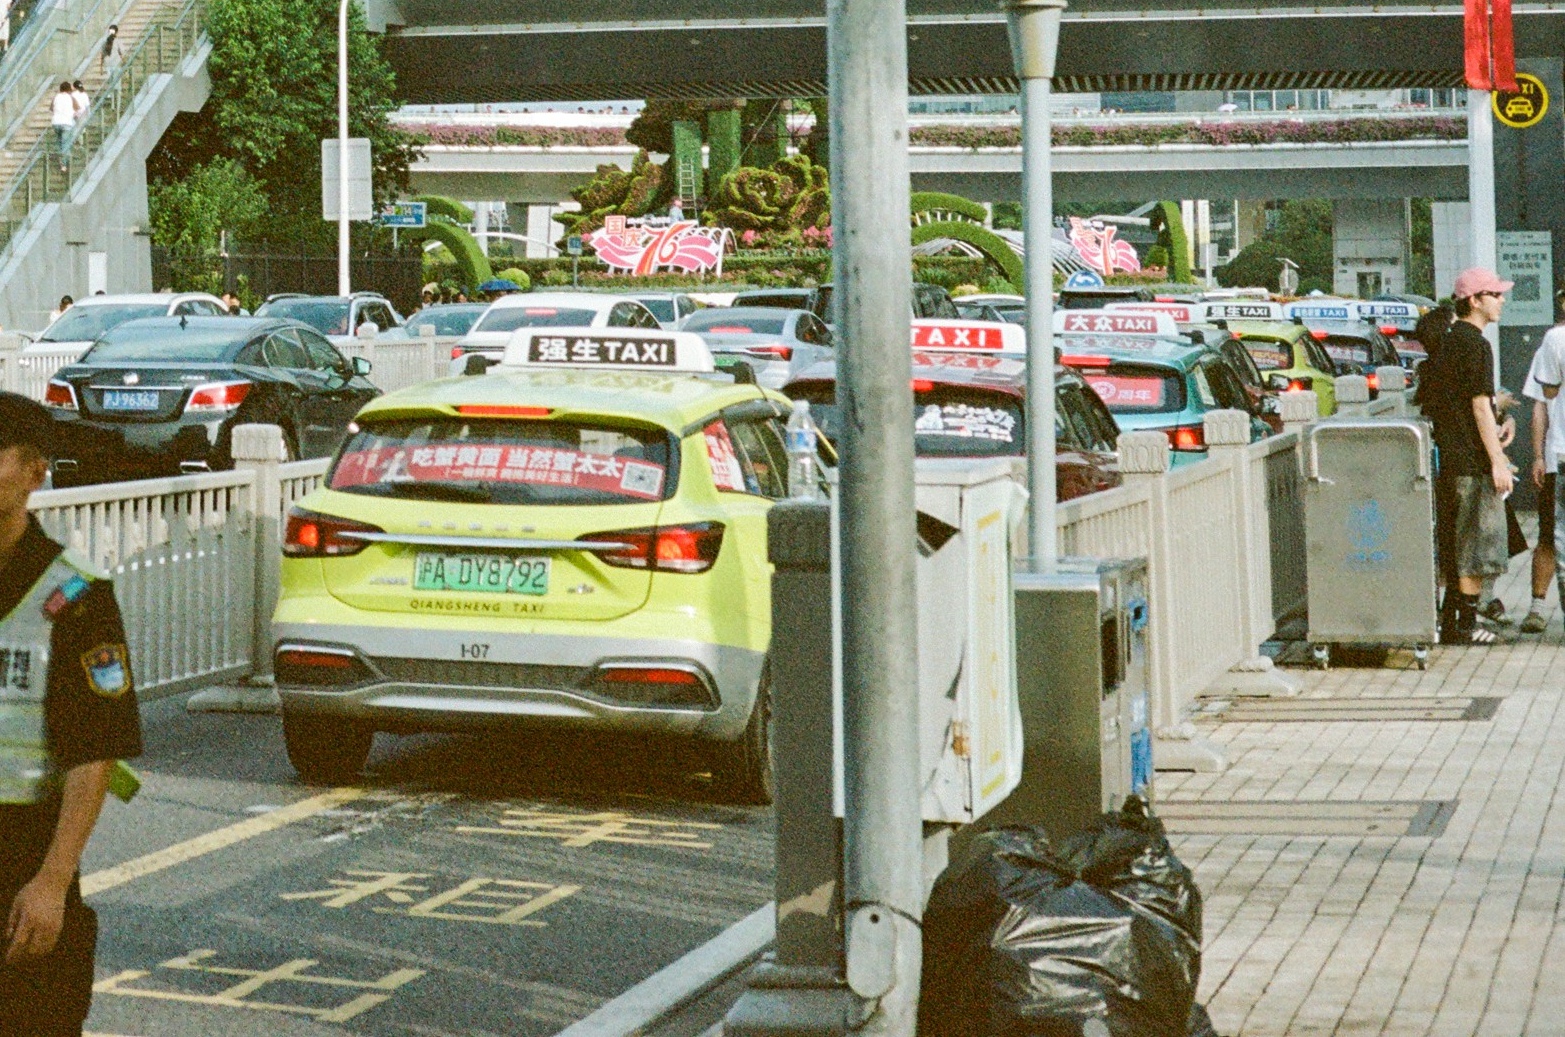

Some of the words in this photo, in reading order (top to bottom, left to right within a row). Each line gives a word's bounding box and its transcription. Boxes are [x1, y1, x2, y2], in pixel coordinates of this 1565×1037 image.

[1070, 316, 1152, 331] 大众TAXI
[538, 338, 668, 363] 强生TAXI
[459, 559, 546, 588] DY8792
[410, 600, 501, 612] QIANGSHENG
[514, 603, 544, 613] TAXI
